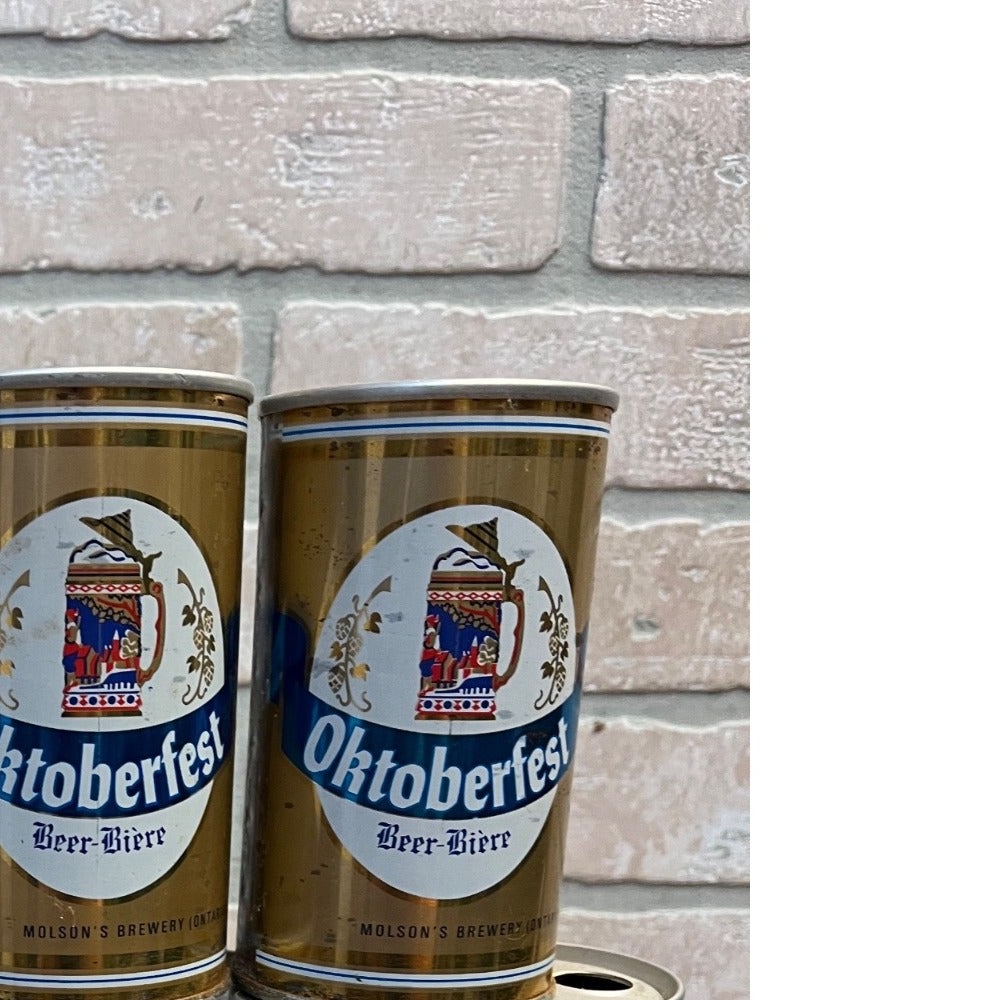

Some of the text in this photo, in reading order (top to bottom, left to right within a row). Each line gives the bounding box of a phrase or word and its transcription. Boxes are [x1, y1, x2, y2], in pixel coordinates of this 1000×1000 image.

[303, 714, 570, 812] Oktoberfest
[32, 821, 167, 855] Beer-Bière
[376, 821, 512, 856] Beer-Bière
[23, 924, 109, 940] MOLSON'S
[117, 920, 184, 937] BREWERY
[360, 922, 448, 940] MOLSON'S
[456, 921, 523, 939] BREWERY
